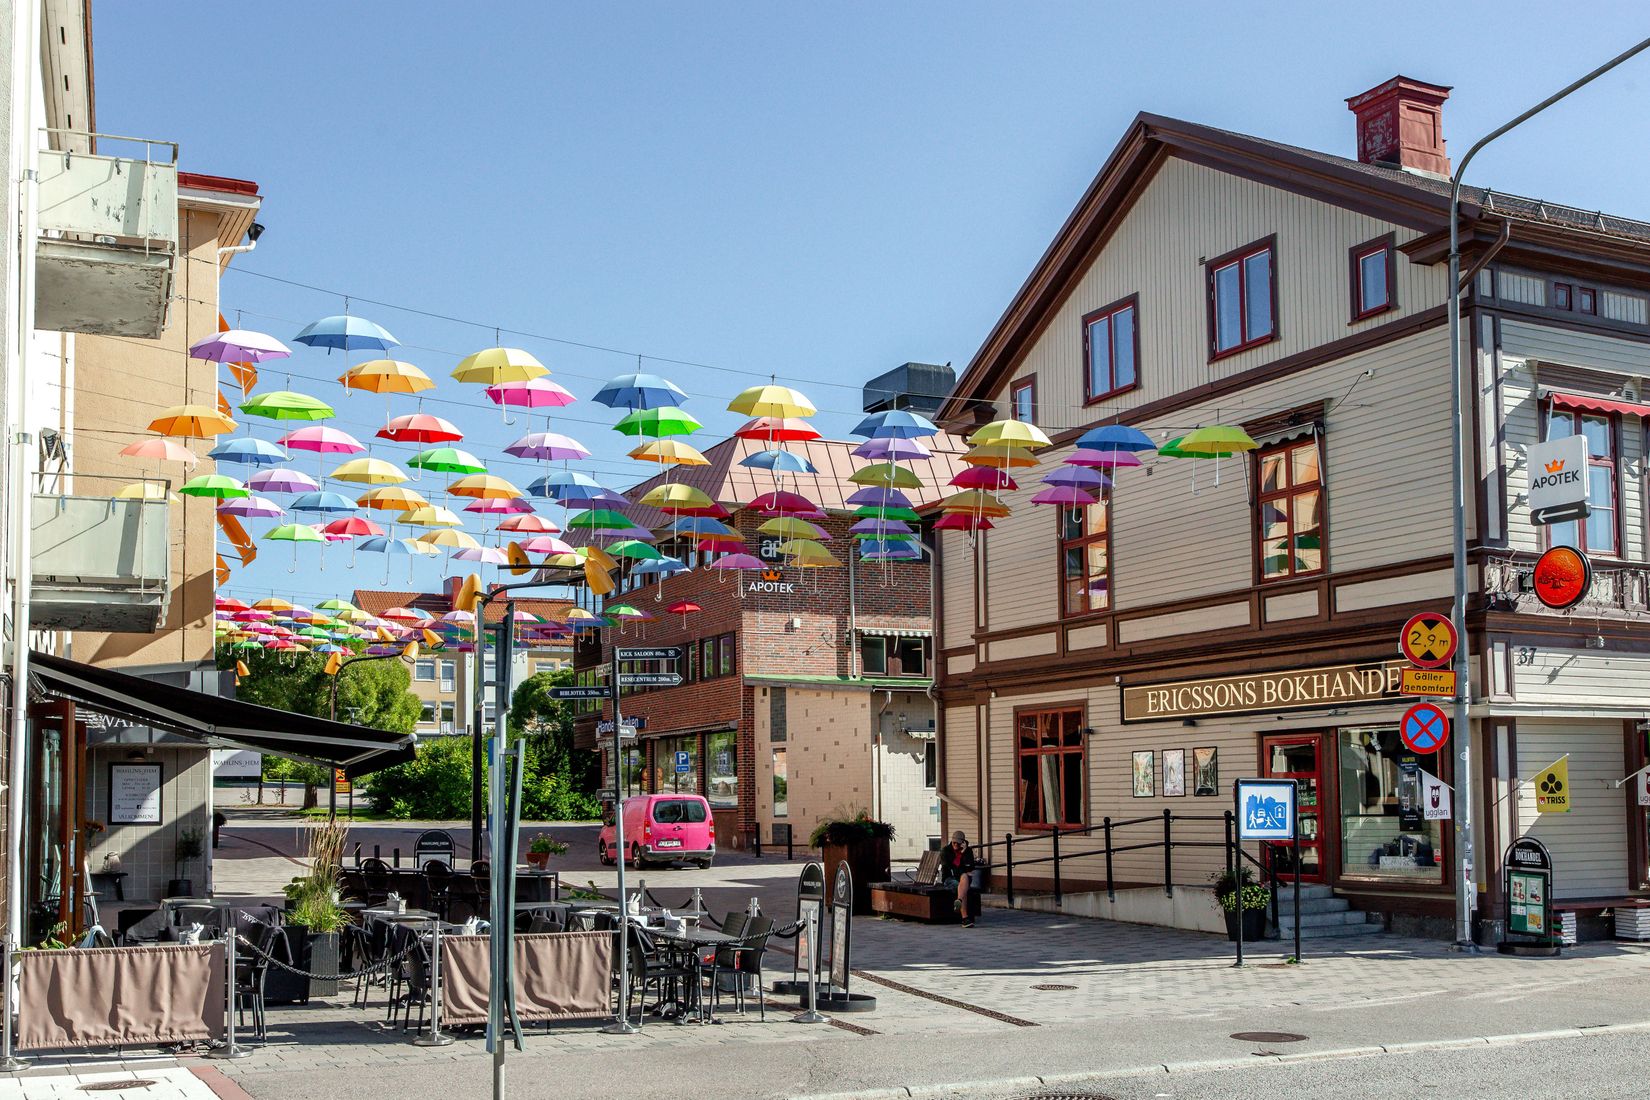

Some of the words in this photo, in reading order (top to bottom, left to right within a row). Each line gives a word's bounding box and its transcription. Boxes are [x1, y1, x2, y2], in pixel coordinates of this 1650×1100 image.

[1532, 470, 1580, 490] APOTEK
[749, 582, 794, 593] APOTEK
[1519, 647, 1537, 664] 37
[1414, 672, 1443, 681] Gäller
[1147, 681, 1257, 713] ERICSSONS
[1262, 665, 1410, 703] BOKHANDE
[1404, 684, 1454, 693] genomfart
[678, 753, 687, 764] P
[1546, 796, 1566, 804] TRISS
[1425, 808, 1448, 818] ugglan
